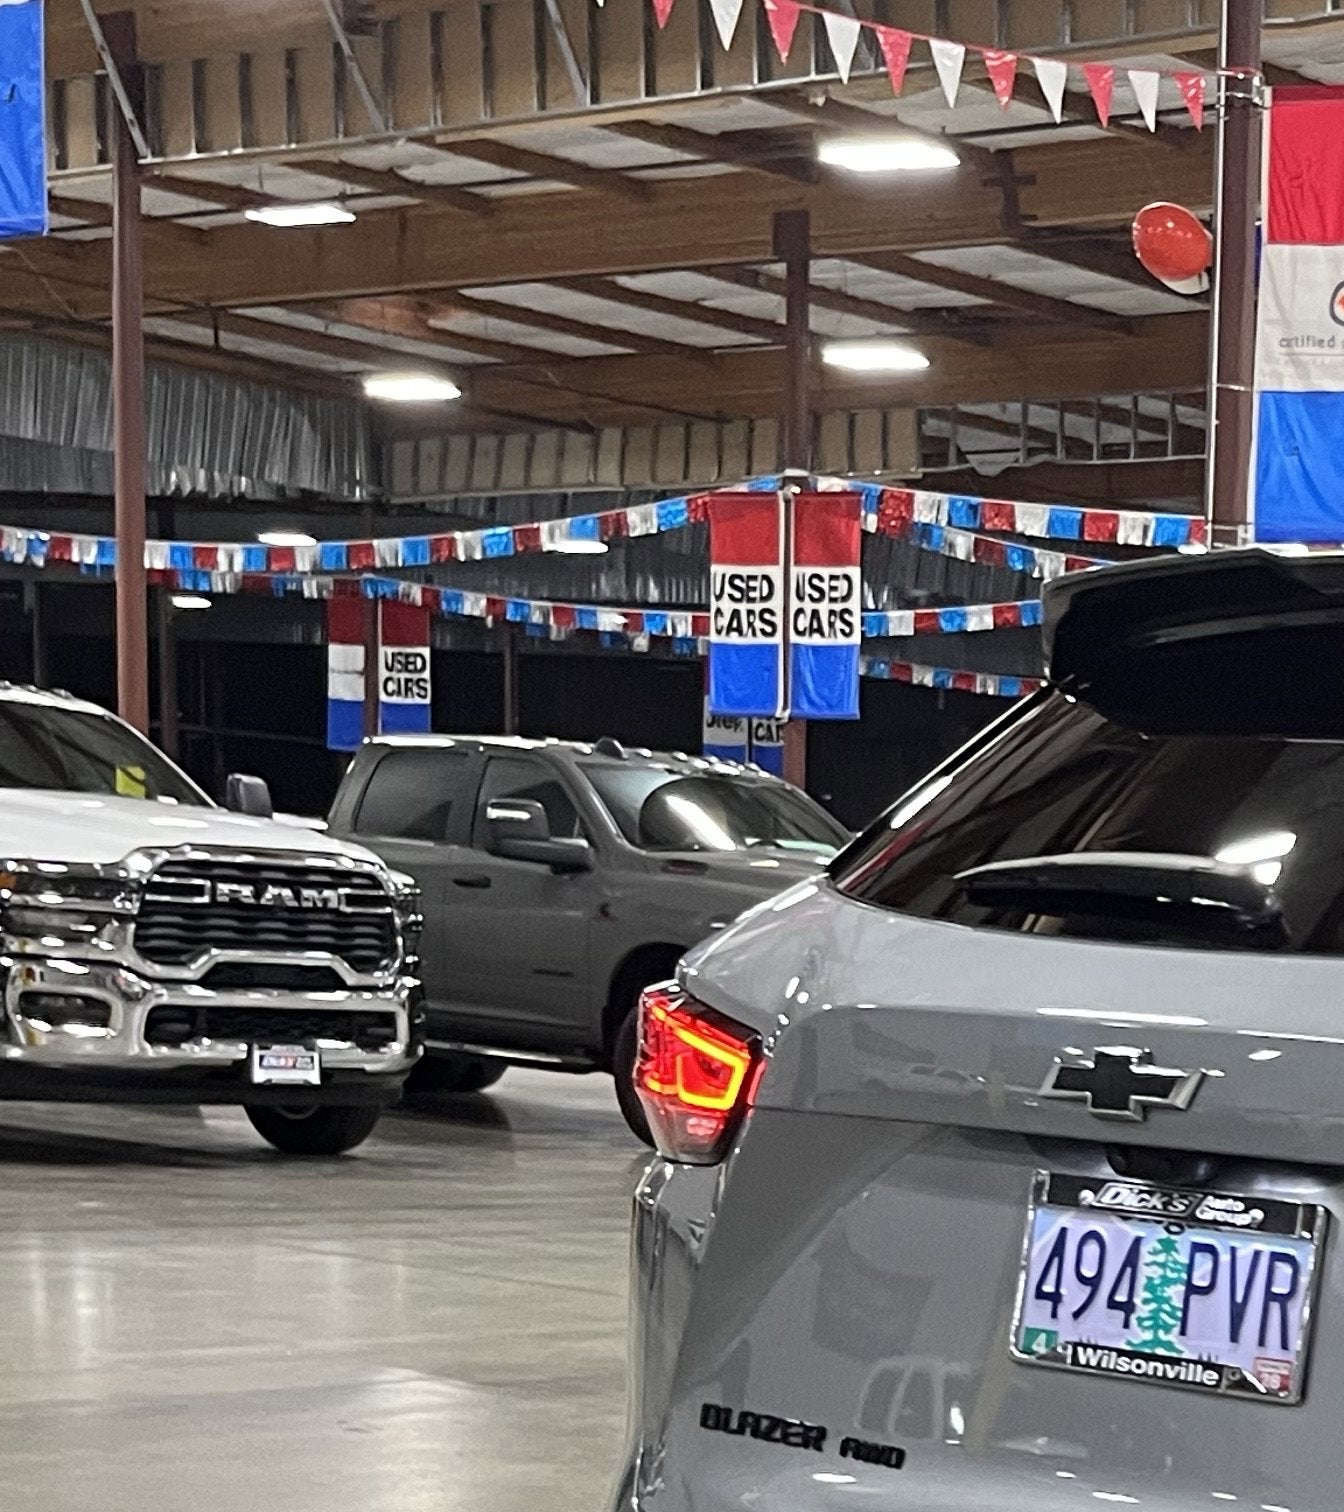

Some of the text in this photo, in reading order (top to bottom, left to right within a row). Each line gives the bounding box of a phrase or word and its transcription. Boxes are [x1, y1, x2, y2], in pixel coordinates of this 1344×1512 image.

[713, 573, 774, 603] USED
[796, 573, 853, 604] USED
[713, 608, 777, 637] CARS
[793, 607, 854, 638] CARS
[384, 651, 427, 673] USED
[216, 882, 340, 909] RAM
[1100, 1186, 1190, 1212] Dick's
[1034, 1226, 1300, 1351] 494 PVR
[1031, 1332, 1047, 1354] 4
[1077, 1344, 1219, 1387] Wilsonville
[700, 1403, 827, 1452] BLAZER
